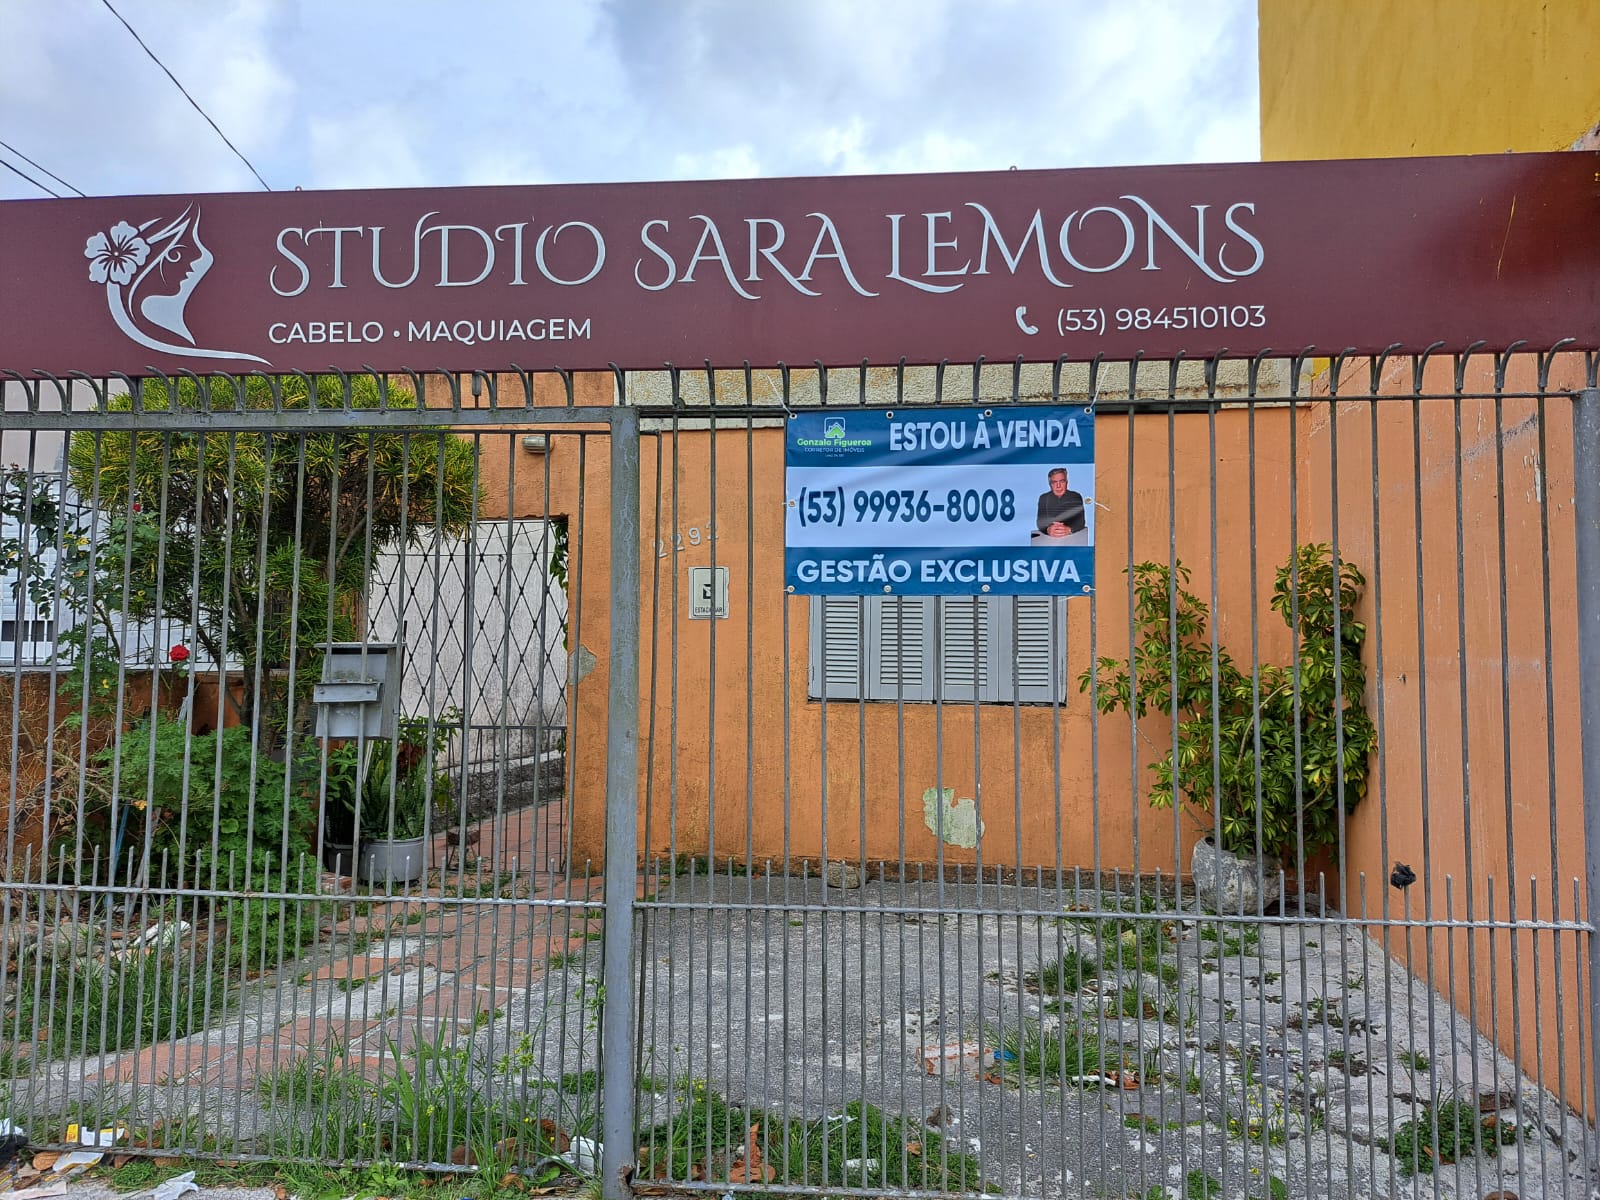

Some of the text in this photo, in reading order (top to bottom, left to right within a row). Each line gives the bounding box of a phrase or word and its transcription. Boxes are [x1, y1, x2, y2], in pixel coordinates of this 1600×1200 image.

[269, 194, 1266, 300] STUDIO SARA LEMONS
[268, 318, 591, 345] CABELO MAQUIAGEM
[1057, 305, 1267, 336] (53) 984510103
[797, 438, 872, 447] Gonzalo Figueroa
[889, 413, 1082, 451] ESTOU À VENDA
[799, 486, 1015, 527] (53) 99936-8008
[796, 554, 1081, 583] GESTÃO EXCLUSIVA
